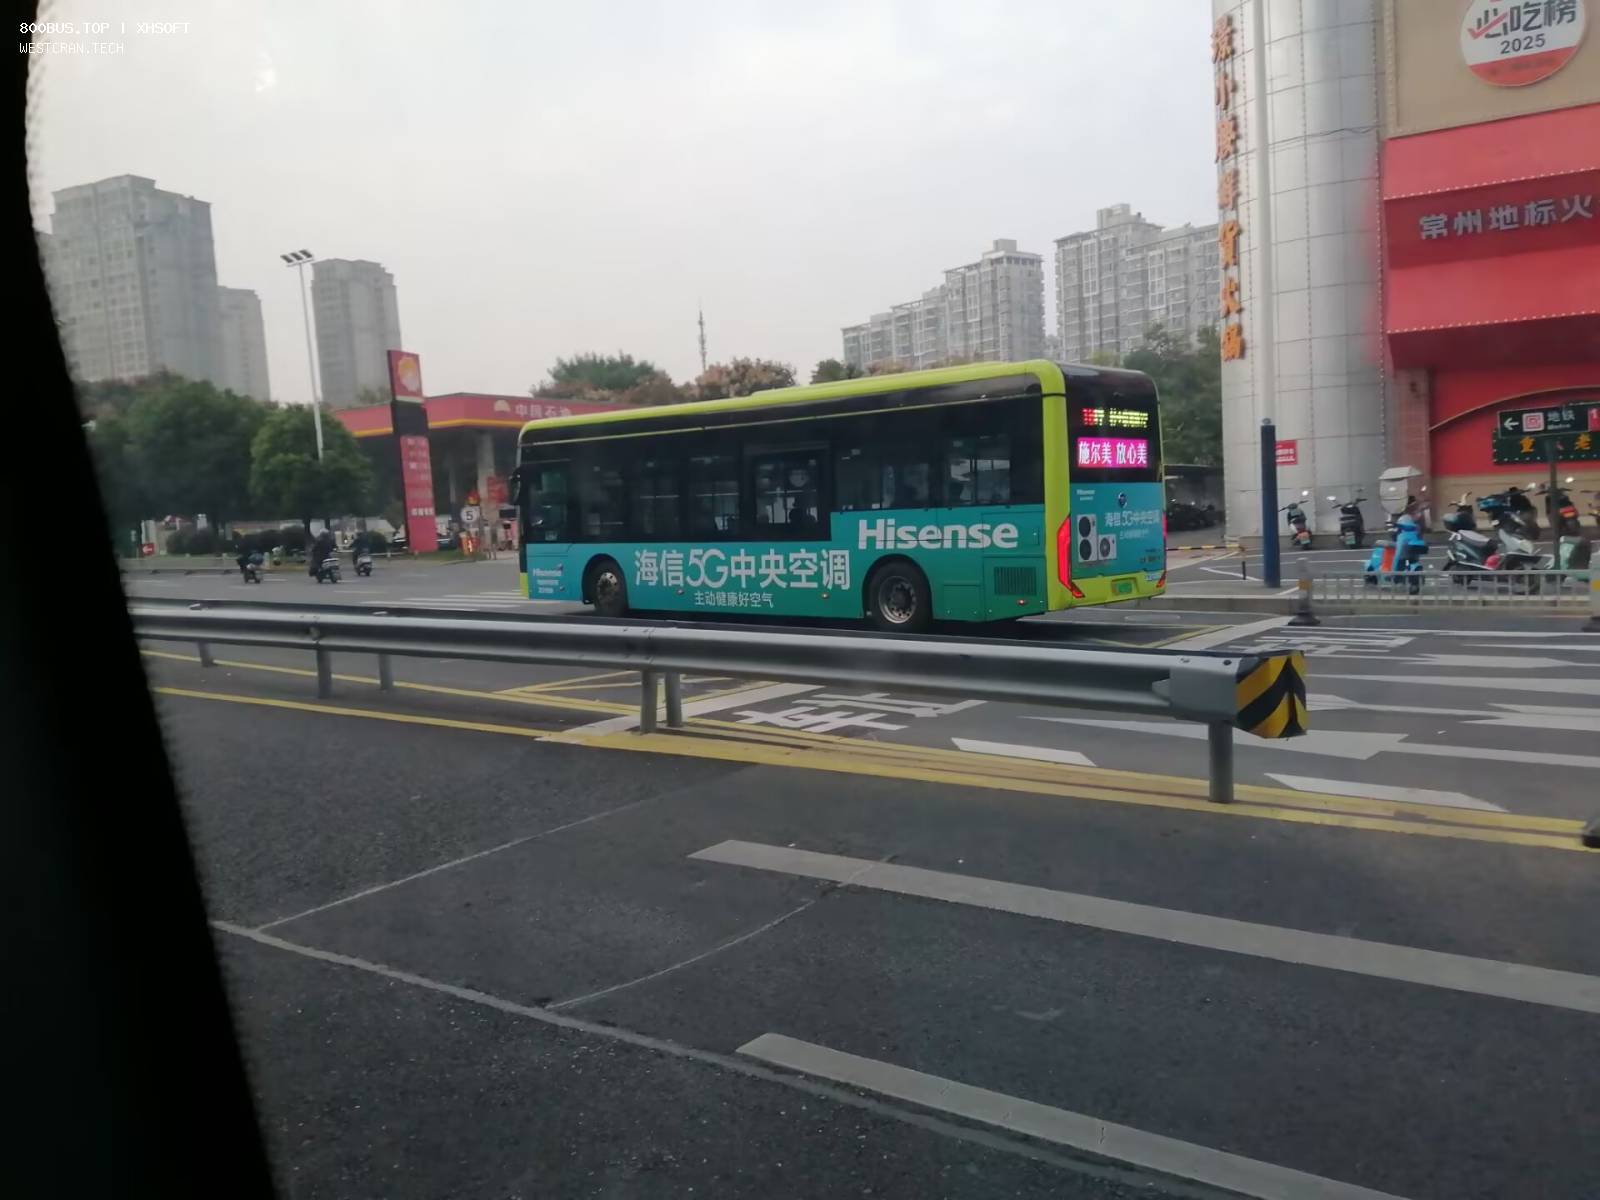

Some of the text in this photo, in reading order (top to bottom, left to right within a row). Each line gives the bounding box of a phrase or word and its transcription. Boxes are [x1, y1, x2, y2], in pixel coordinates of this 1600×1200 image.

[1467, 0, 1577, 39] 必吃榜
[1500, 33, 1546, 55] 2025
[1419, 194, 1593, 241] 常州地标火
[515, 403, 572, 420] 中国石油
[1547, 404, 1575, 422] 地铁
[1116, 441, 1148, 465] 放心美
[857, 518, 1019, 551] Hisense
[634, 548, 851, 591] 海信5G中央空调
[694, 591, 775, 609] 主动健康好空气
